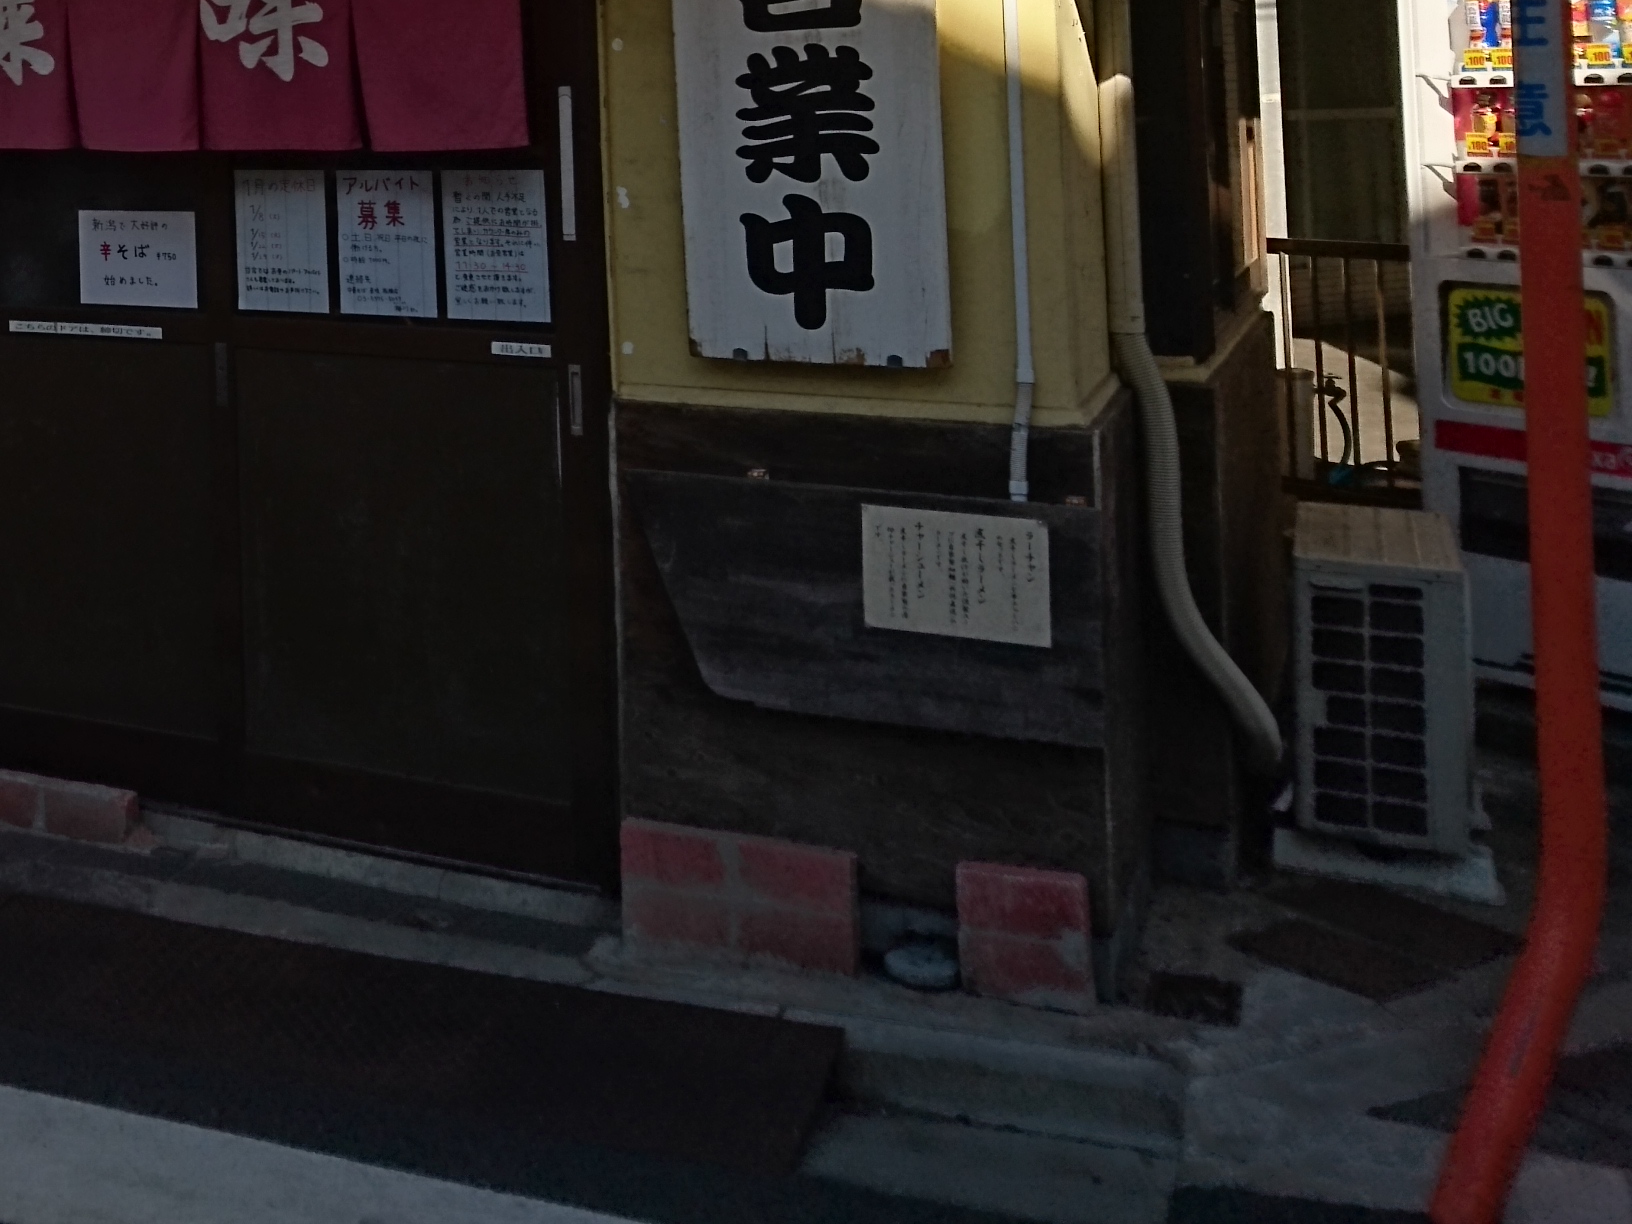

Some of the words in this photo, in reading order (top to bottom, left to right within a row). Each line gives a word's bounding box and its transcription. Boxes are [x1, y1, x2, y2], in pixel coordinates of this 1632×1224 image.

[342, 176, 419, 195] アルバイト
[357, 200, 405, 230] 募集
[99, 241, 150, 261] 辛そば
[1466, 303, 1514, 333] BIG
[501, 344, 543, 355] 出入口
[1463, 351, 1524, 382] 100
